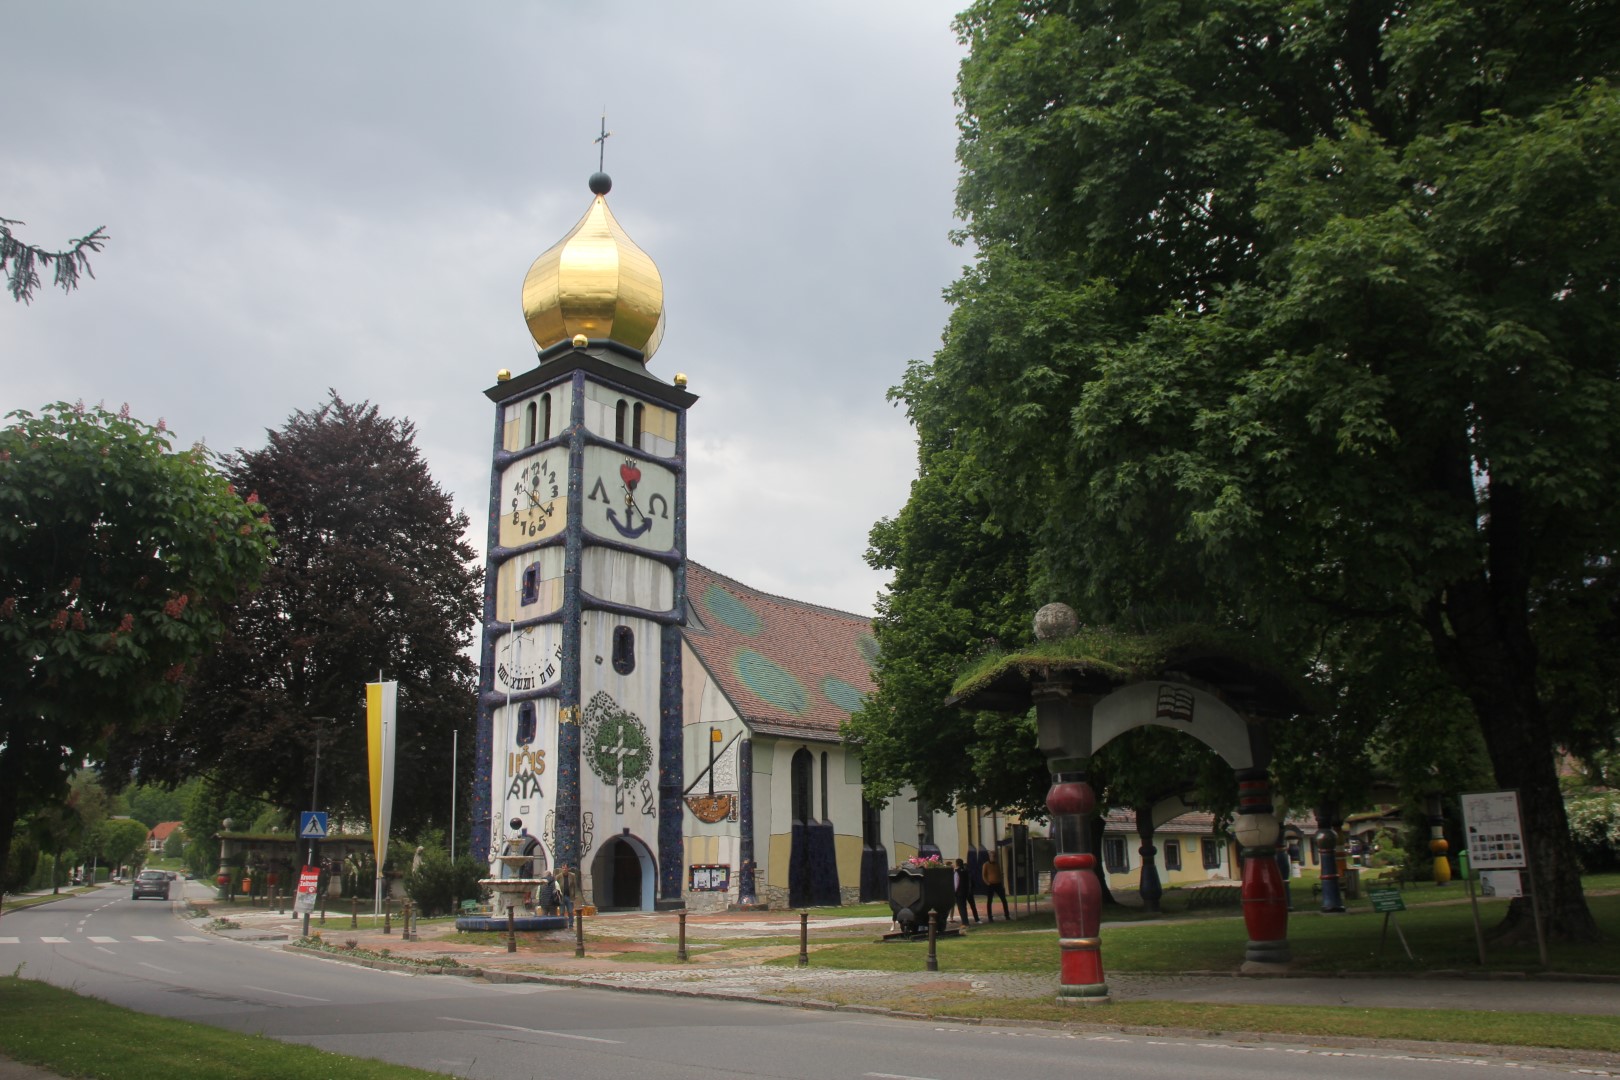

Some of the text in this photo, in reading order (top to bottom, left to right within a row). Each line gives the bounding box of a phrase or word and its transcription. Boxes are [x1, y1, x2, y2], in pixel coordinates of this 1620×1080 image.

[521, 467, 529, 483] 11
[531, 462, 540, 475] 12
[541, 459, 548, 476] 1
[548, 471, 556, 484] 2
[551, 485, 559, 498] 3
[511, 498, 518, 512] 9
[546, 502, 554, 517] 4
[513, 512, 519, 525] 8
[537, 515, 546, 531] 5
[521, 521, 527, 535] 7
[529, 521, 536, 537] 6
[531, 677, 535, 688] I
[540, 672, 546, 685] II
[546, 663, 555, 678] III
[508, 749, 546, 777] IHS
